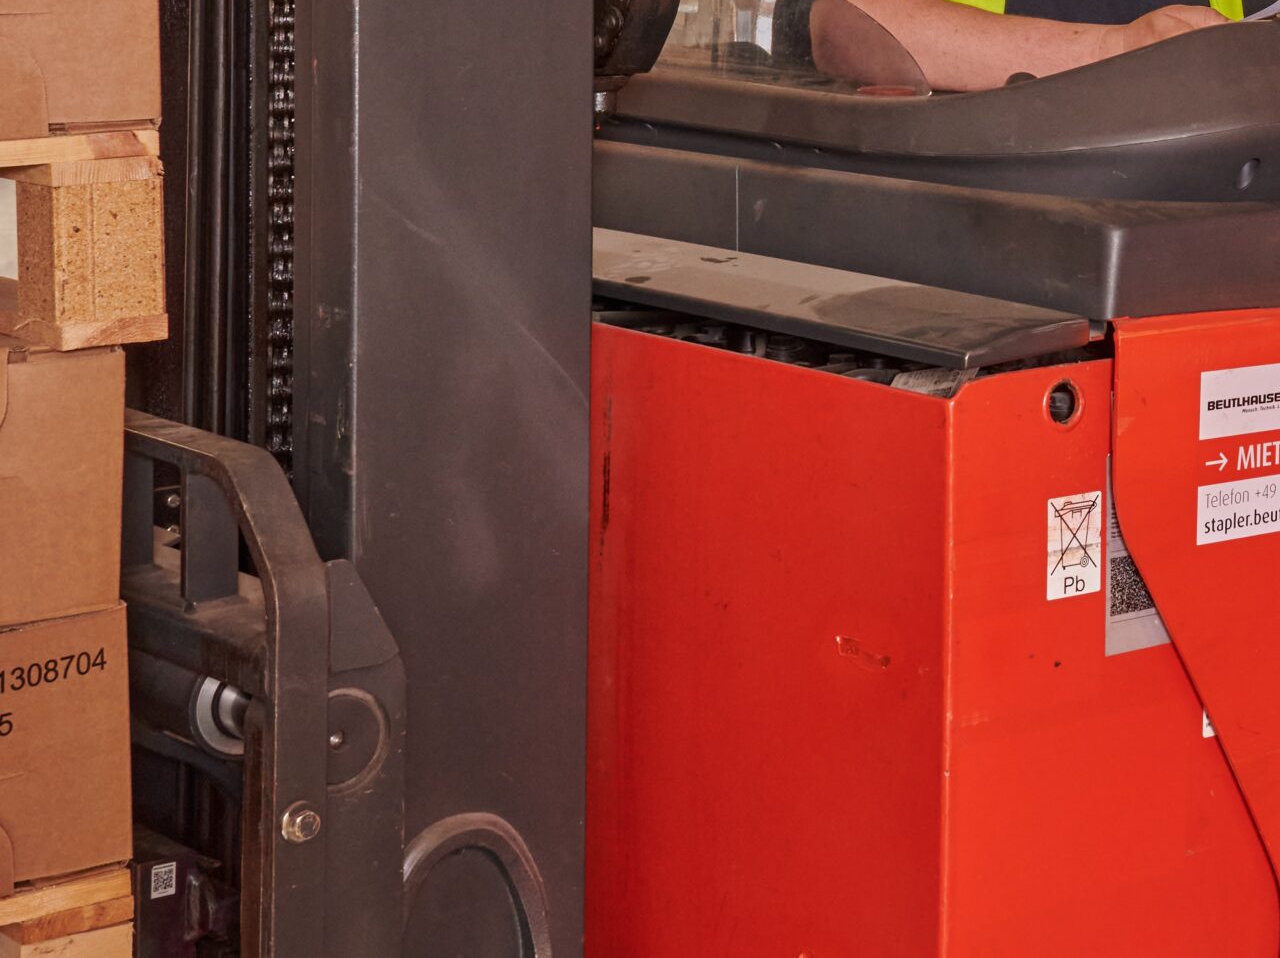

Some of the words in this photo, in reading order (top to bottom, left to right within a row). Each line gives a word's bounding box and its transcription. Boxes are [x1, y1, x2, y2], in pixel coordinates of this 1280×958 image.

[1205, 488, 1249, 508] Telefon
[1255, 483, 1277, 499] +49
[1063, 576, 1086, 594] Pb
